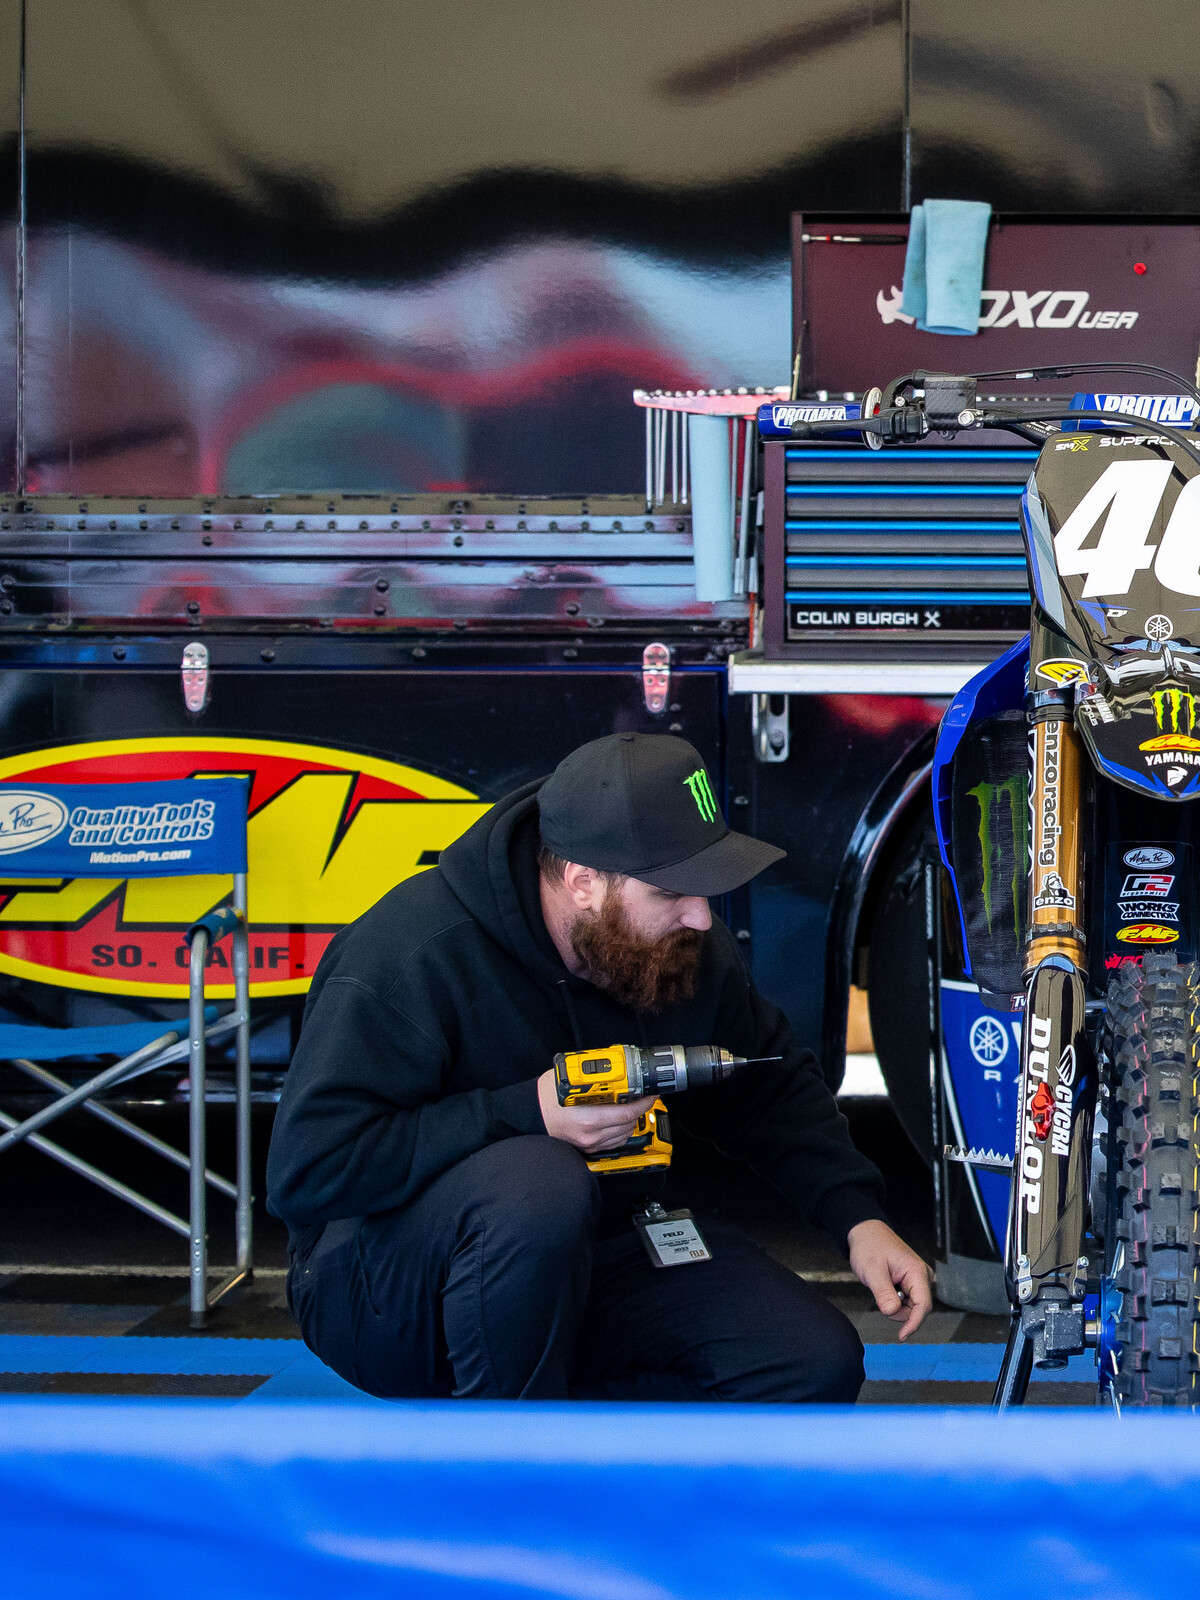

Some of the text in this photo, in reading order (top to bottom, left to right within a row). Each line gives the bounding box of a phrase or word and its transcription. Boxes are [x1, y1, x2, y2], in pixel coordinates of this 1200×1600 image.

[979, 290, 1139, 329] OXO USA
[1054, 436, 1093, 453] SMX
[796, 611, 919, 625] COLIN BURGH
[1038, 721, 1061, 867] enzoracing
[71, 801, 213, 829] Quality Tools
[71, 821, 212, 845] and Controls
[89, 850, 191, 864] MotionPro.com
[1035, 895, 1074, 907] enzo
[1120, 902, 1178, 912] WORKS
[1121, 911, 1177, 920] CONNECTION
[1117, 926, 1180, 940] FMF
[91, 944, 304, 969] SO. CAIF.
[1051, 1084, 1074, 1157] CYCRA
